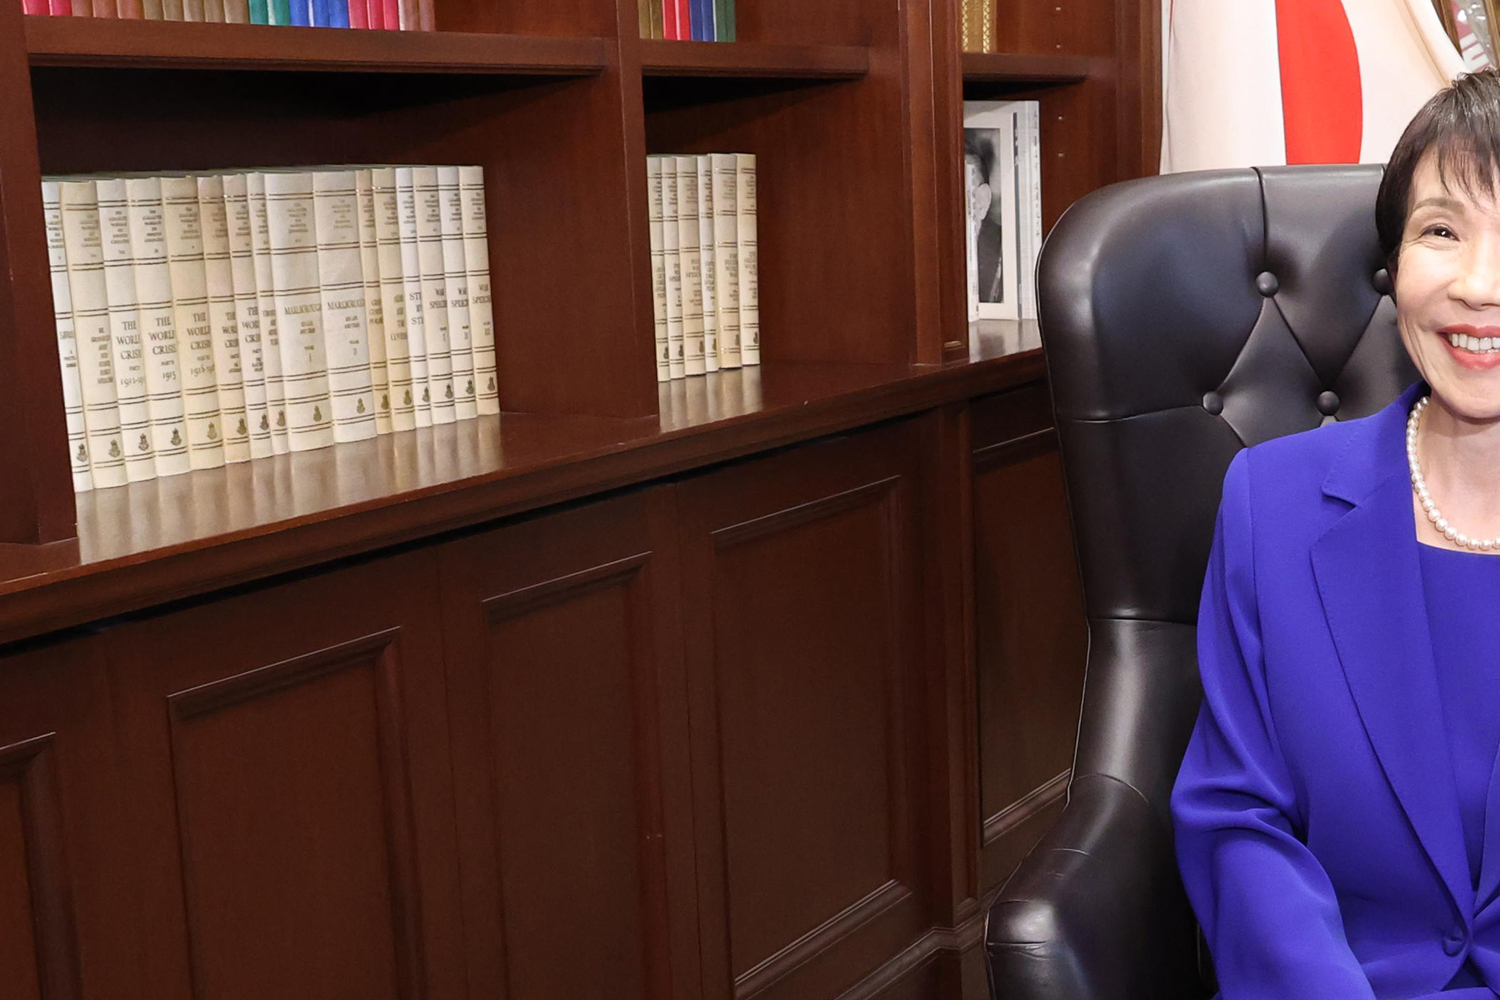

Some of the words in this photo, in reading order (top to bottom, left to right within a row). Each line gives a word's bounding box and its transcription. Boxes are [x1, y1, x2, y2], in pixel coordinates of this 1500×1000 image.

[156, 317, 172, 327] THE
[194, 313, 207, 323] THE
[122, 321, 138, 331] THE
[117, 335, 140, 346] WORL
[163, 372, 177, 382] 1915
